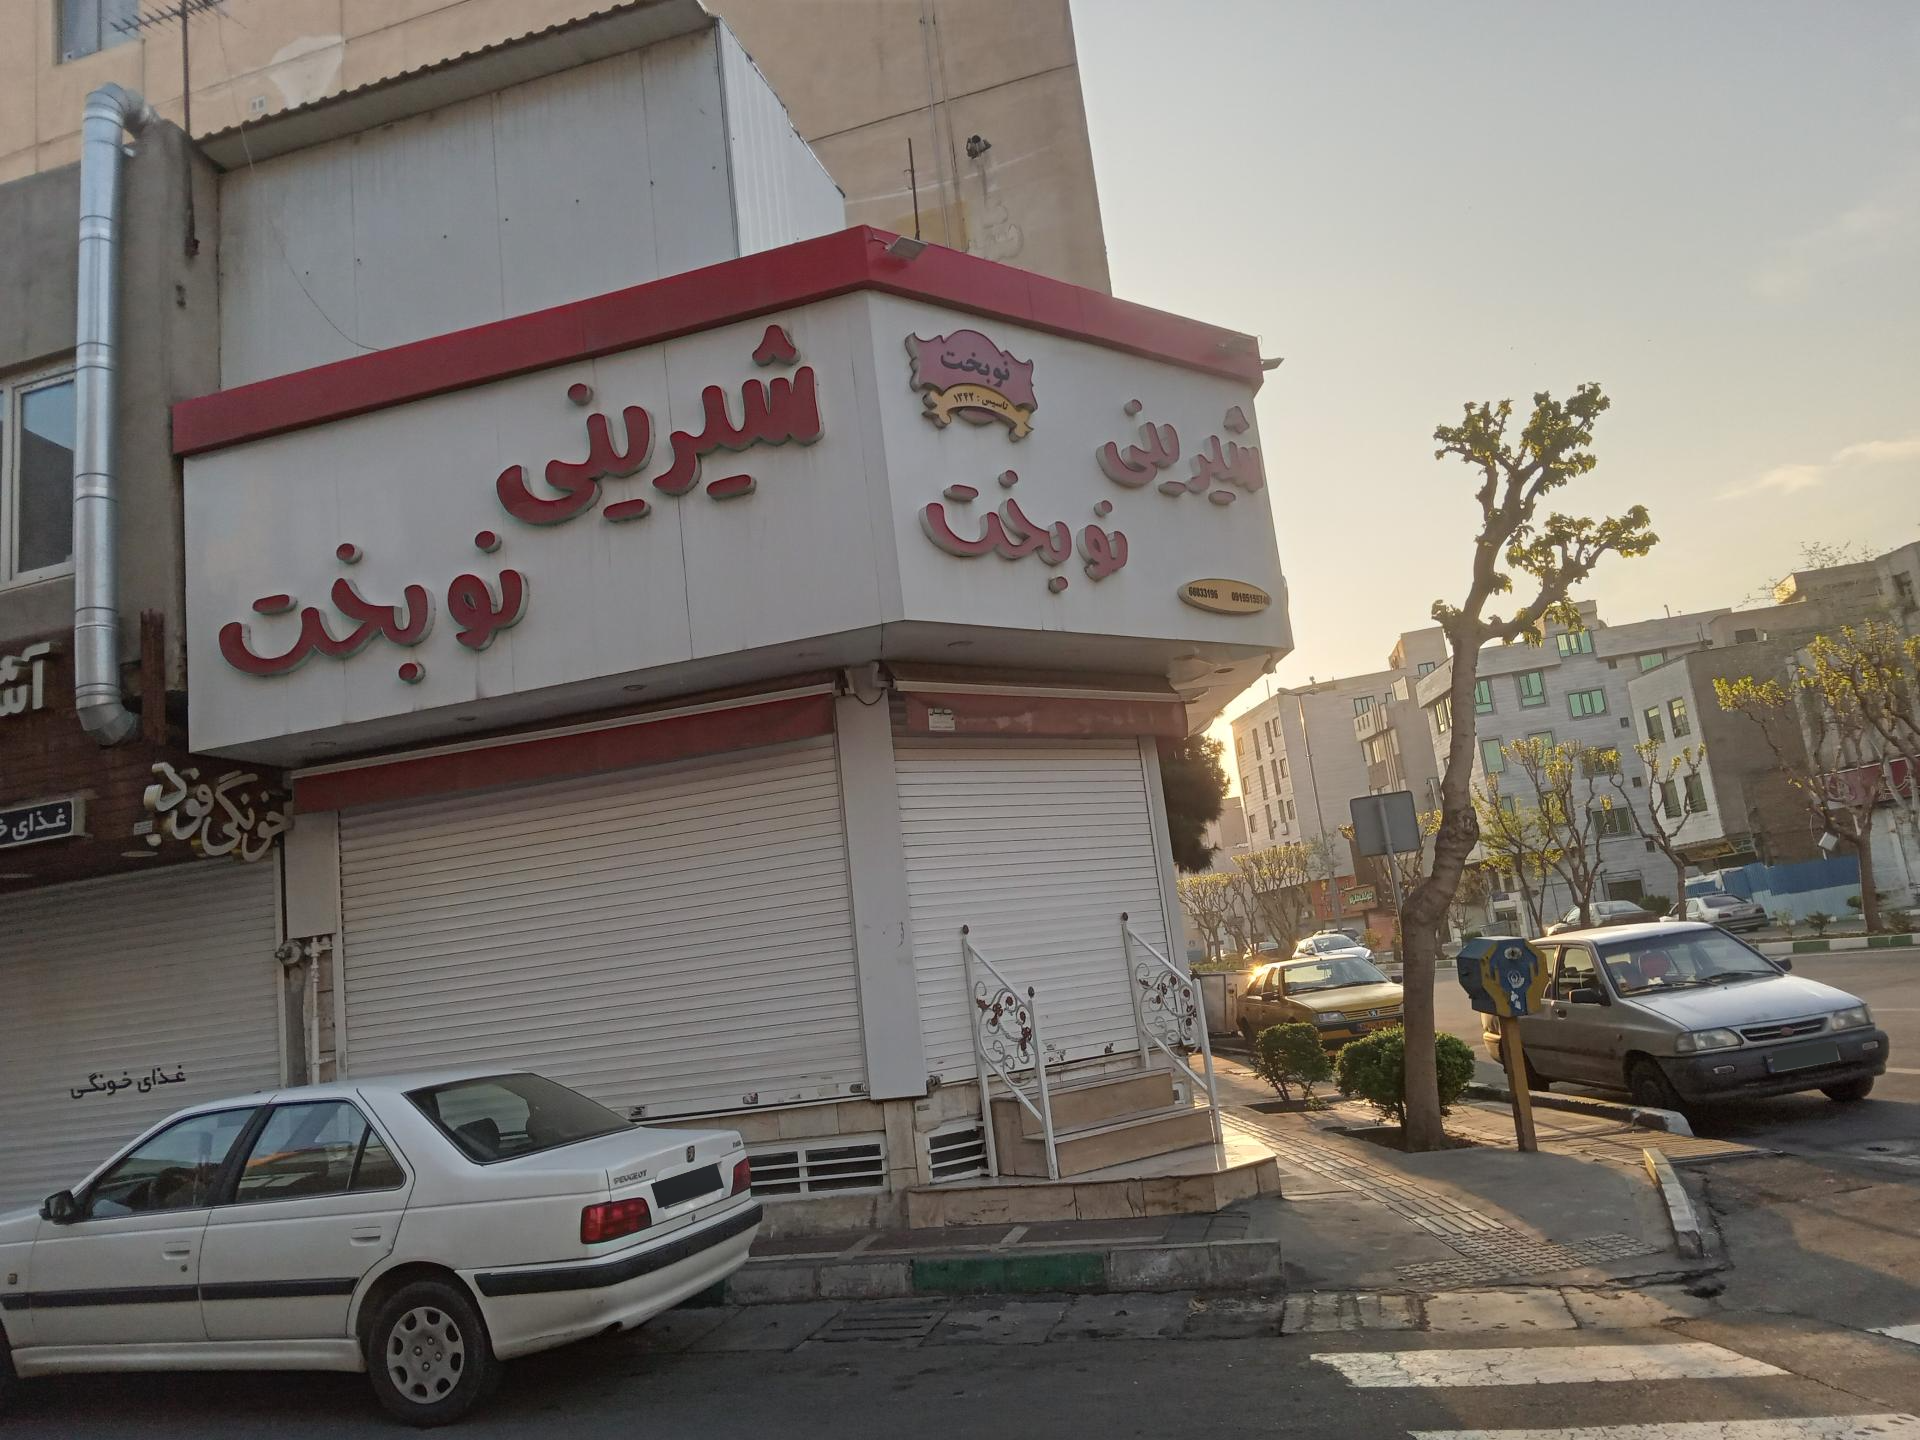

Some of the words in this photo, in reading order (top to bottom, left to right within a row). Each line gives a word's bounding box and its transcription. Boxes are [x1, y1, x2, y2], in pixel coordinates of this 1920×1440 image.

[941, 352, 1010, 387] نوبخت
[496, 324, 824, 526] شیرینی
[1096, 399, 1264, 505] شیرینی
[919, 470, 1128, 593] نوبخت
[219, 531, 529, 683] نوبخت
[12, 808, 66, 840] غذای
[202, 771, 292, 862] خونگی
[70, 1071, 132, 1099] خونگی
[138, 1065, 186, 1093] غذای
[614, 1169, 647, 1184] PEUGEOT
